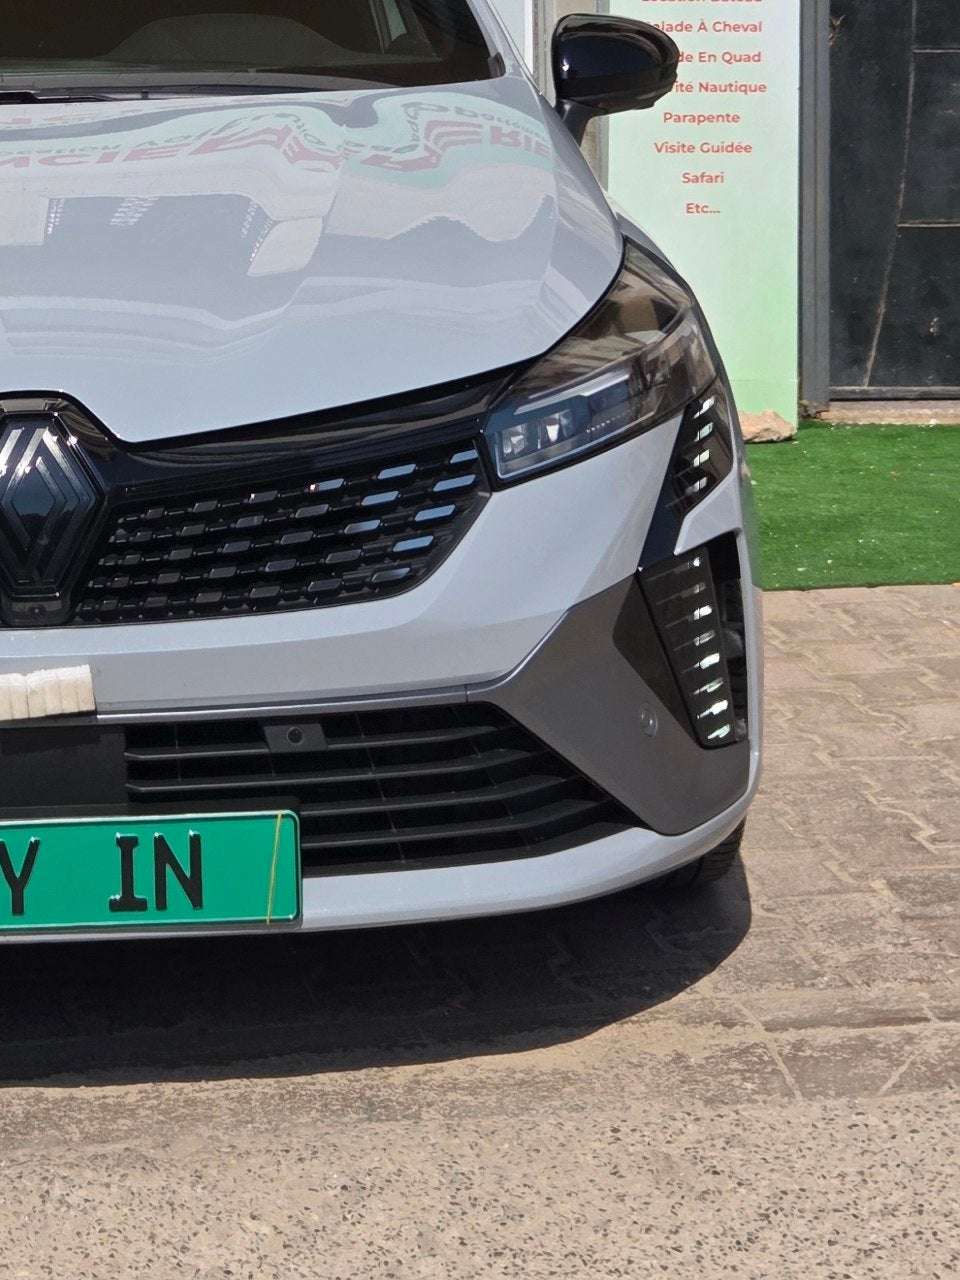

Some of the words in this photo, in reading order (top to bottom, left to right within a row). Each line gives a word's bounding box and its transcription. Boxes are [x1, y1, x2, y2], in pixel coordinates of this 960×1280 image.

[712, 21, 763, 33] Cheval
[699, 52, 717, 63] En
[721, 51, 762, 64] Quad
[699, 80, 768, 95] Nautique
[663, 112, 741, 126] Parapente
[654, 141, 696, 154] Visite
[700, 141, 753, 154] Guidée
[682, 171, 725, 184] Safari
[686, 203, 721, 215] Etc...
[108, 830, 204, 913] IN
